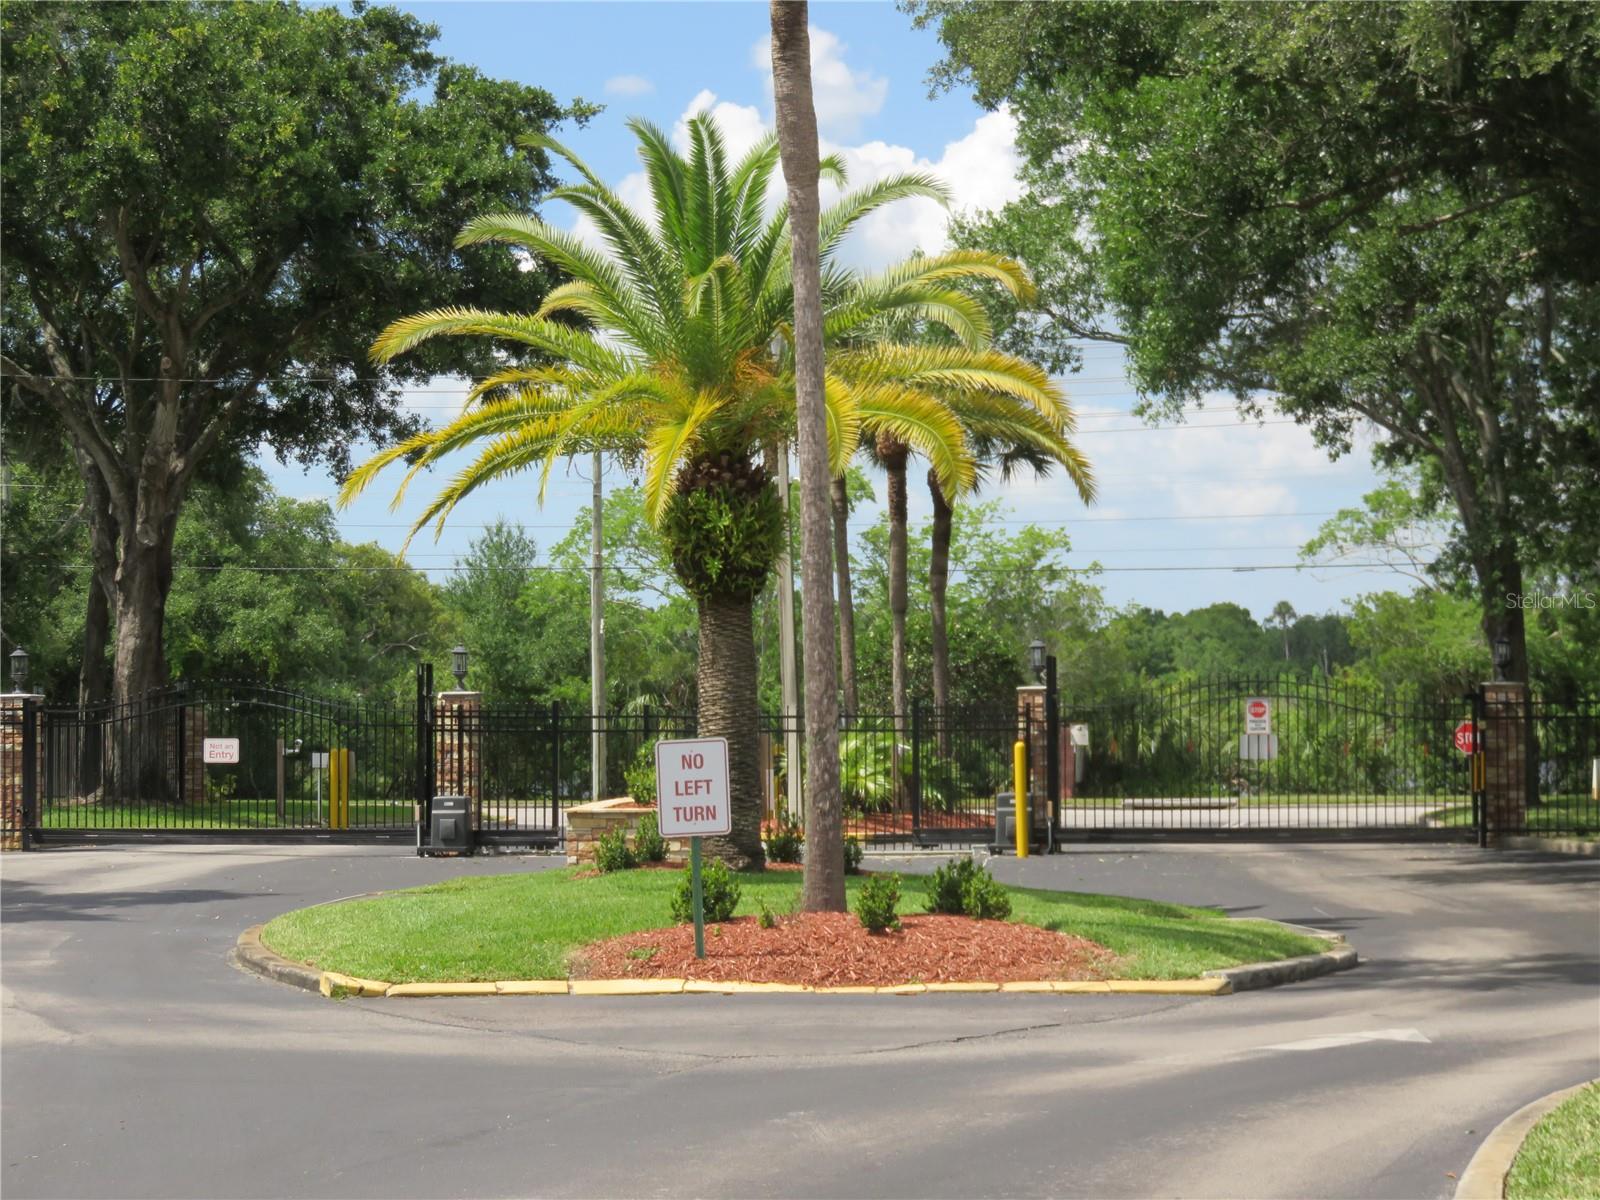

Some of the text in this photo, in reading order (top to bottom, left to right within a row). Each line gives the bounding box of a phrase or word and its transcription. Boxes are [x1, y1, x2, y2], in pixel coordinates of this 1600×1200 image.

[209, 750, 235, 760] Entry
[681, 753, 704, 770] NO
[674, 779, 713, 797] LEFT
[673, 805, 717, 823] TURN
